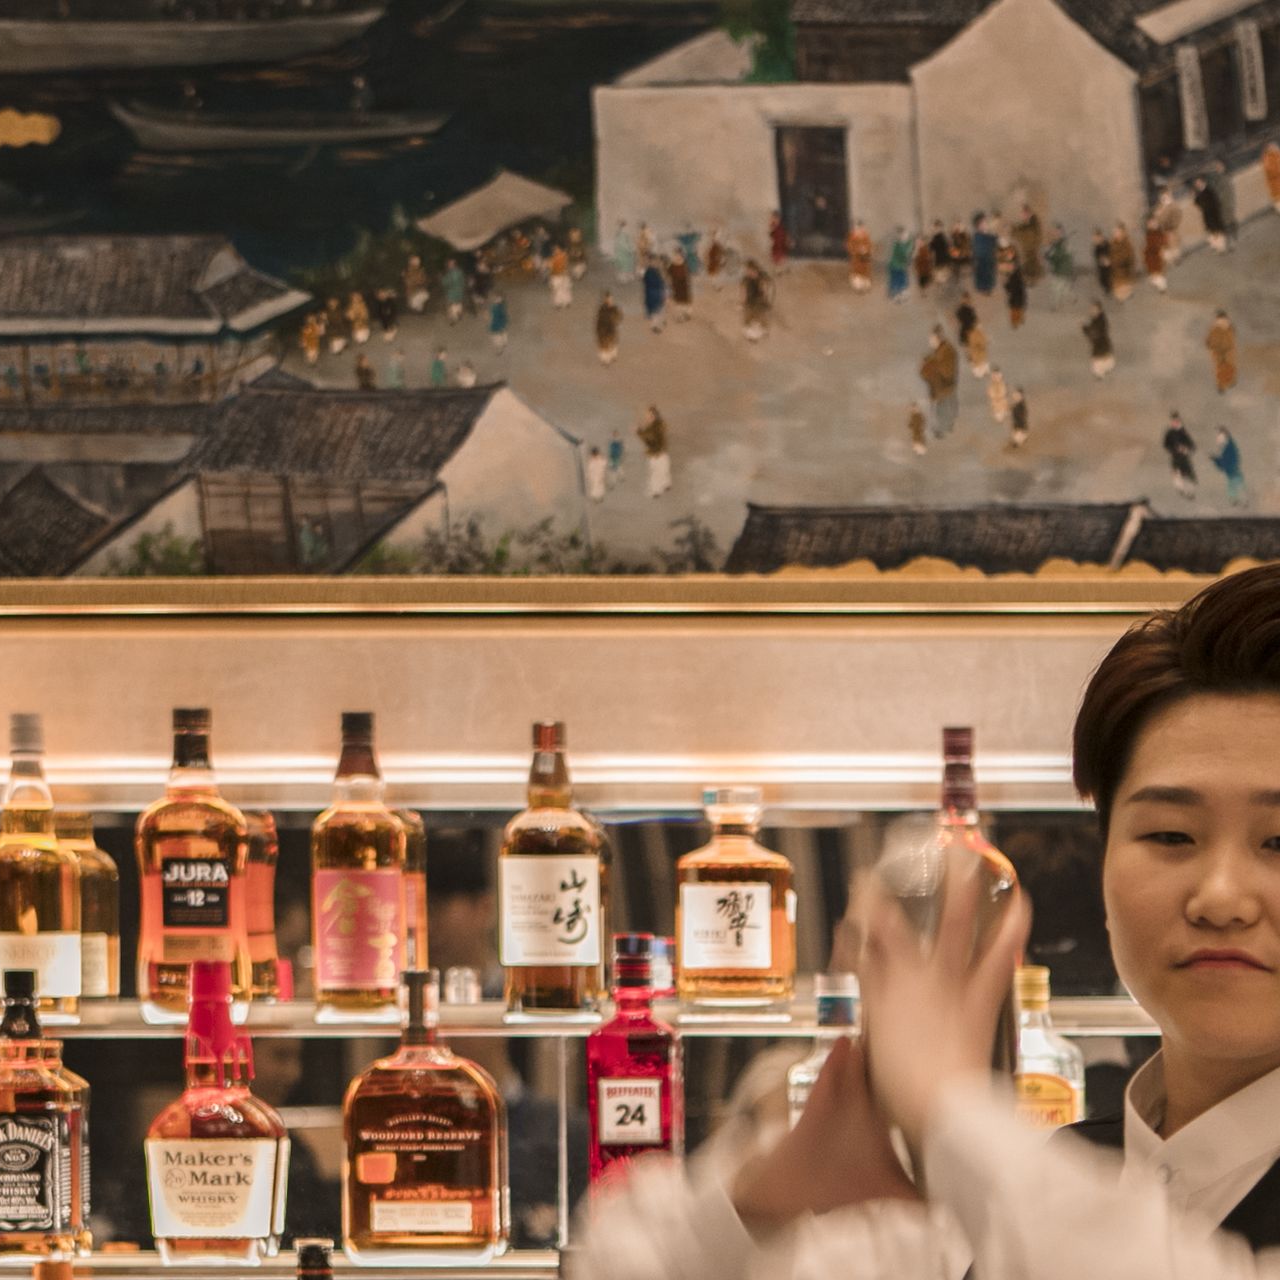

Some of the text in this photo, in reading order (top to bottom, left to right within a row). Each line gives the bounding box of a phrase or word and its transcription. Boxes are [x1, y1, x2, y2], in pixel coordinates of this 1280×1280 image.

[165, 862, 229, 882] JURA
[186, 889, 206, 907] 12
[615, 1103, 647, 1127] 24
[8, 1121, 56, 1152] DANIEL'S
[360, 1131, 482, 1140] WOODFORD RESERVE
[164, 1151, 253, 1167] Maker's
[189, 1170, 252, 1186] Mark
[178, 1195, 240, 1204] WHISKY
